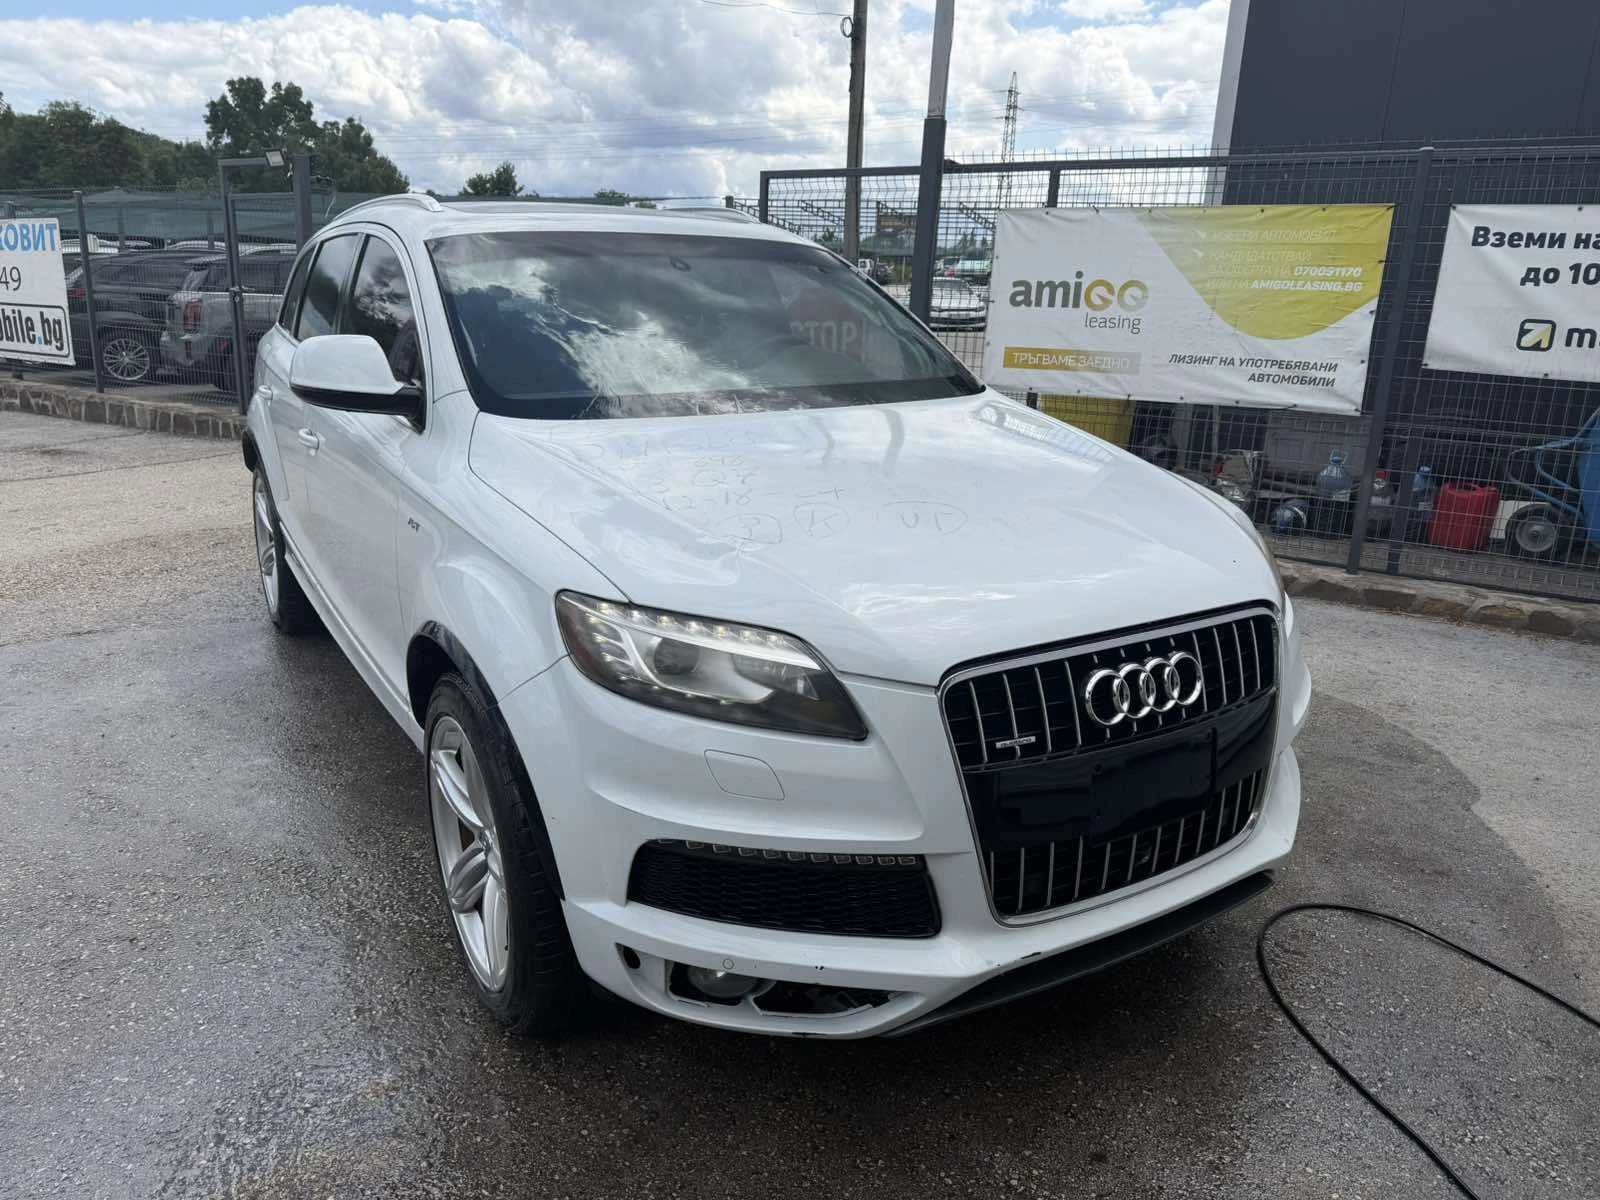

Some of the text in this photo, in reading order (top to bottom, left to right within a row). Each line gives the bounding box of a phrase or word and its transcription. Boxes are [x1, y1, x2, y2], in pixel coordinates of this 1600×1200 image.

[0, 223, 57, 252] ОВИТ
[1471, 226, 1566, 249] Вземи
[1520, 263, 1600, 287] до 10
[1084, 312, 1142, 335] leasing
[1565, 328, 1600, 348] m
[1012, 352, 1077, 367] ТРЪГВАМЕ
[1169, 354, 1338, 373] ЛИЗИНГ НА УПОТРЕБЯВАНИ
[1248, 373, 1336, 387] АВТОМОБИЛИ
